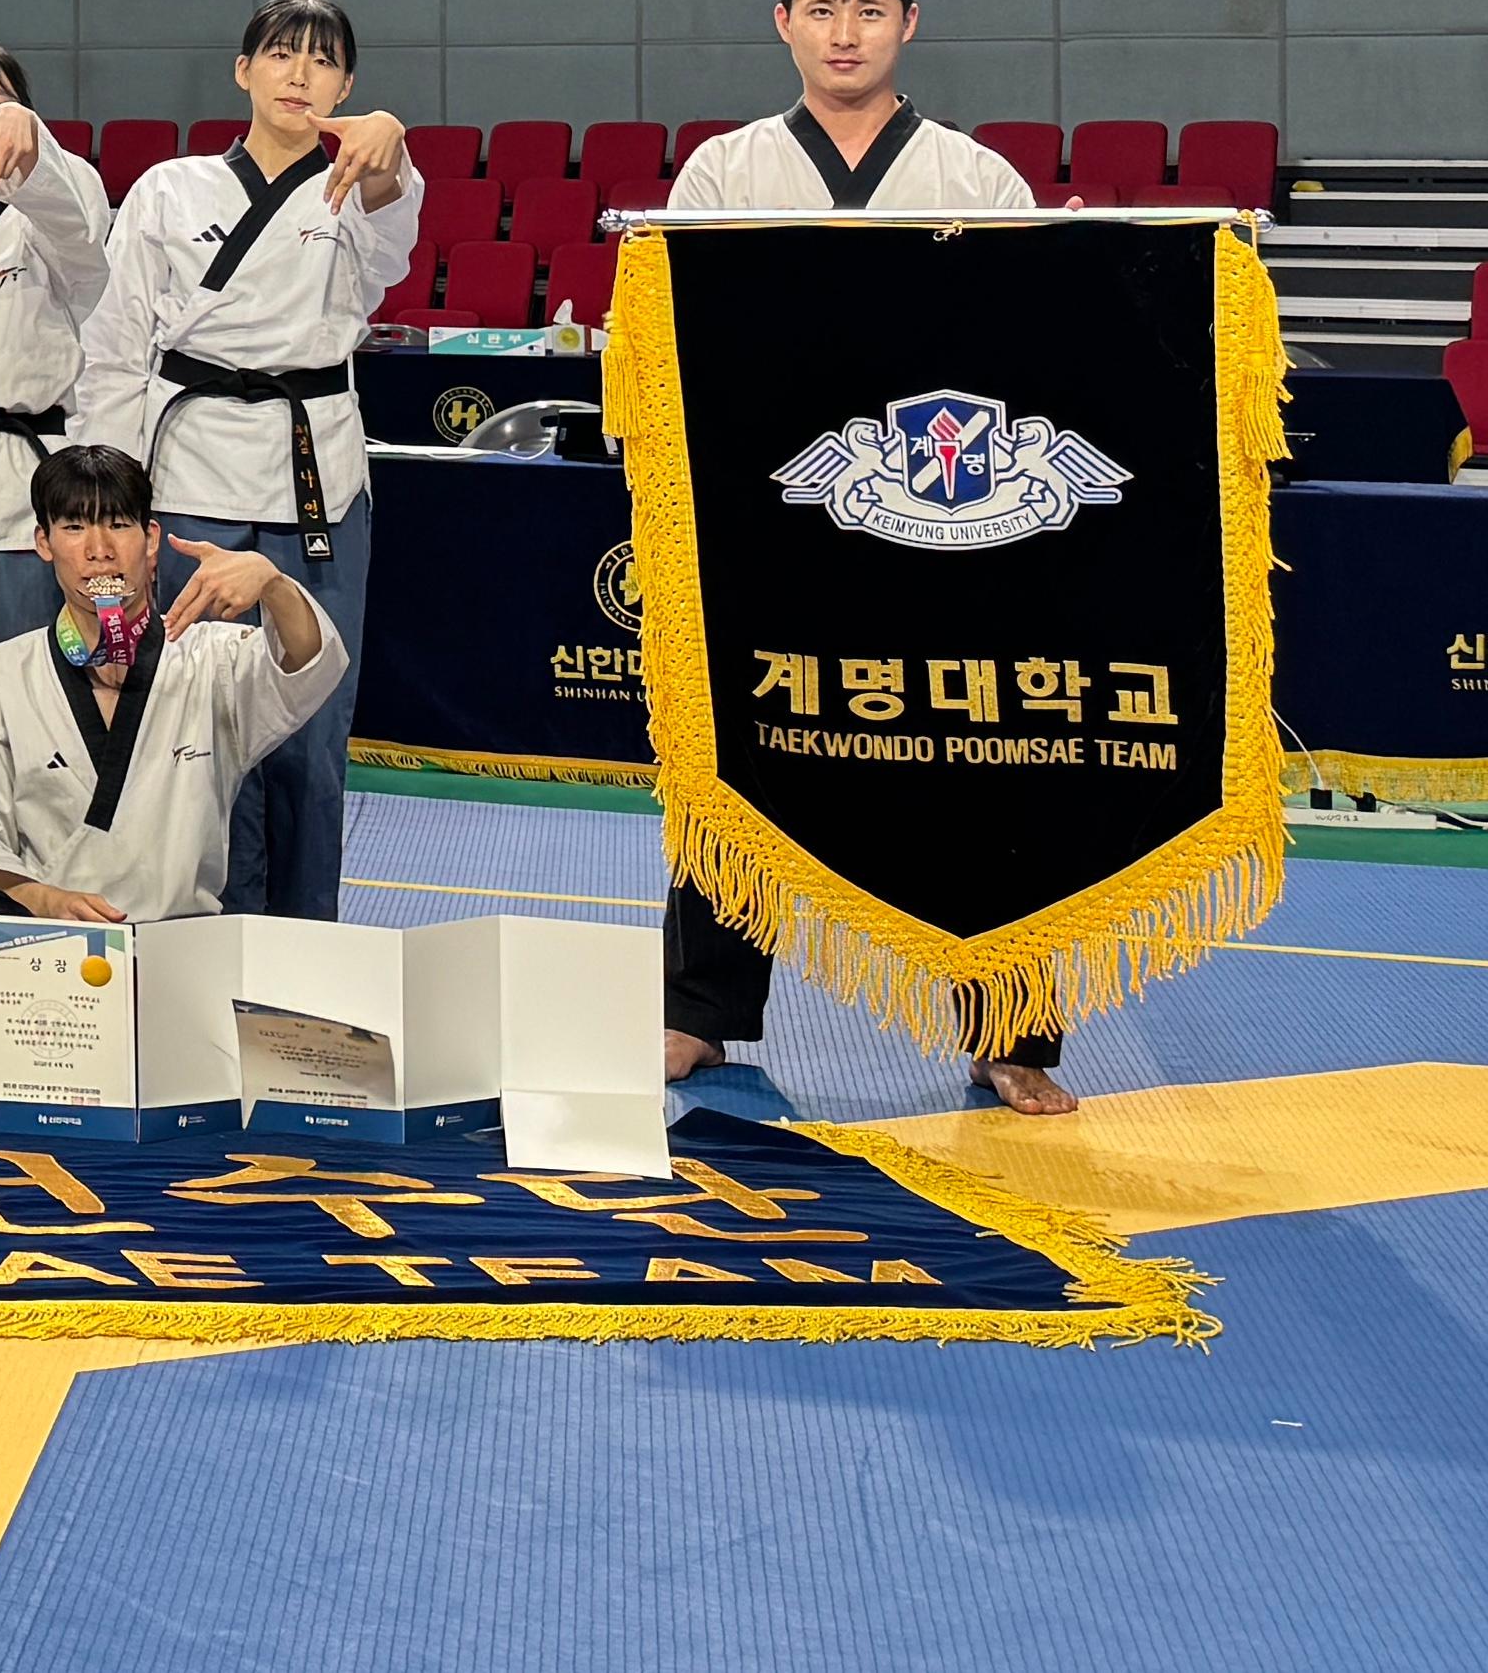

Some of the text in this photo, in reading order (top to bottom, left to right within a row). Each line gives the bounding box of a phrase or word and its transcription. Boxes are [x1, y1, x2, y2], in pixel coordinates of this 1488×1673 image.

[909, 437, 986, 475] 계 명
[871, 512, 1034, 541] KEIMYUNG UNIVERSITY
[554, 686, 631, 701] SHINHAN
[752, 649, 1179, 725] 계명대학교
[754, 720, 1177, 771] TAEKWONDO POOMSAE TEAM
[324, 1252, 944, 1287] TEAM
